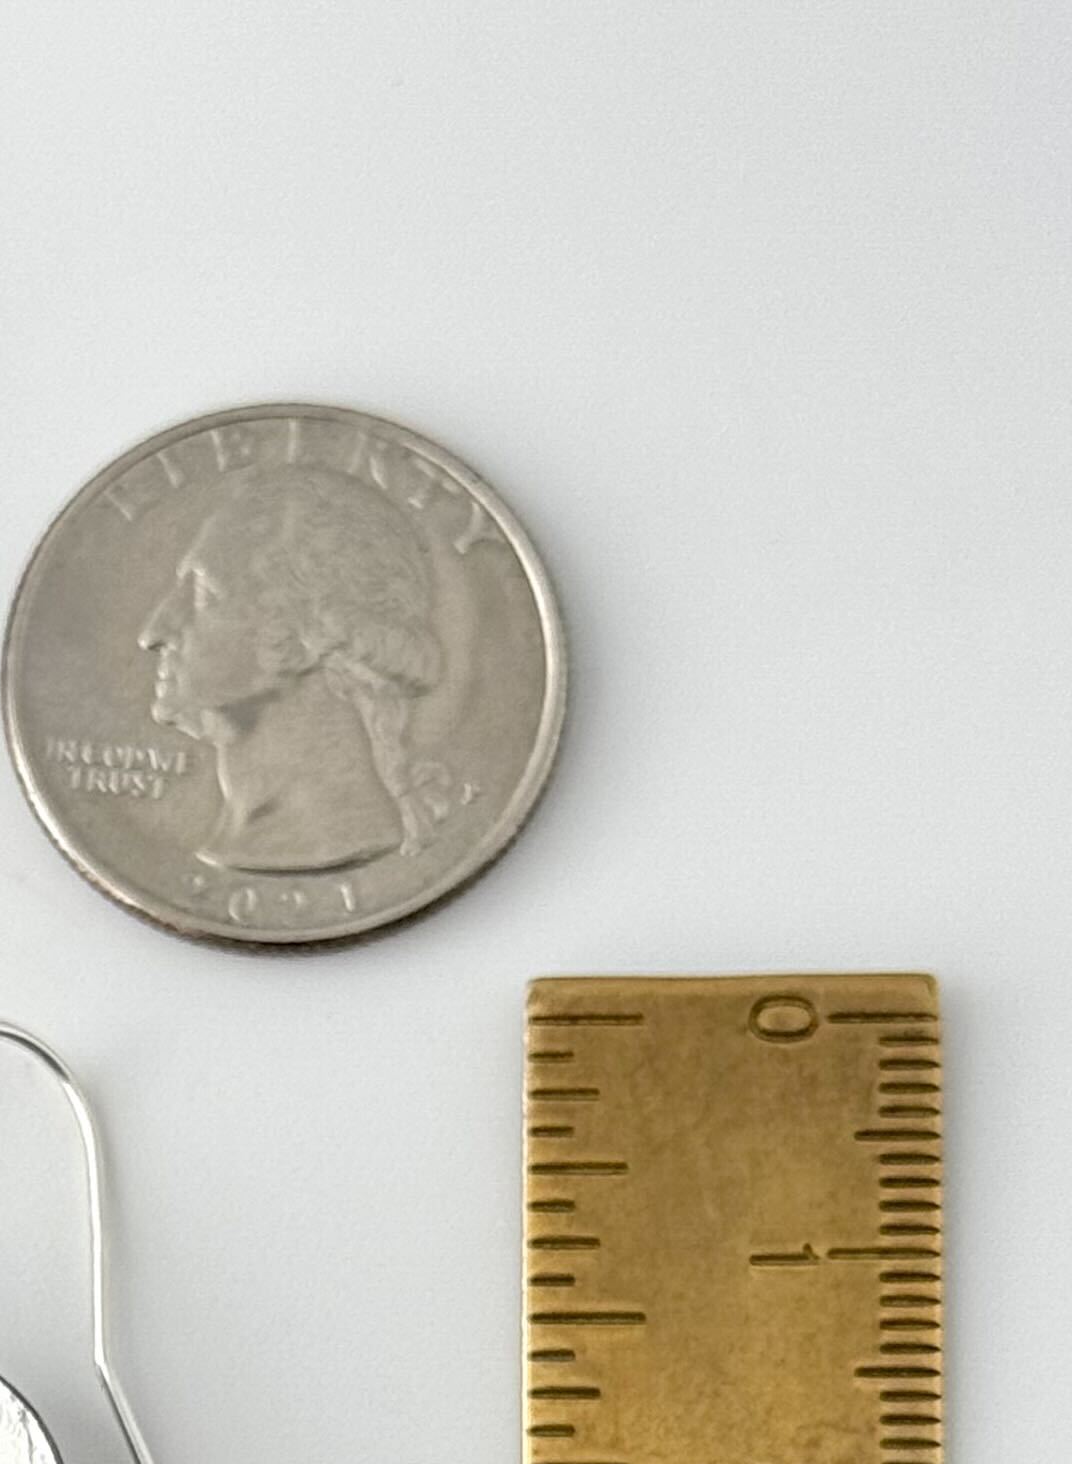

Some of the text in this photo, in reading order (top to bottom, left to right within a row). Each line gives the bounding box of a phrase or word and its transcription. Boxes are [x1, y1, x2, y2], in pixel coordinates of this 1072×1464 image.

[65, 765, 165, 800] TRUST
[748, 993, 818, 1043] 0
[749, 1242, 820, 1266] 1
